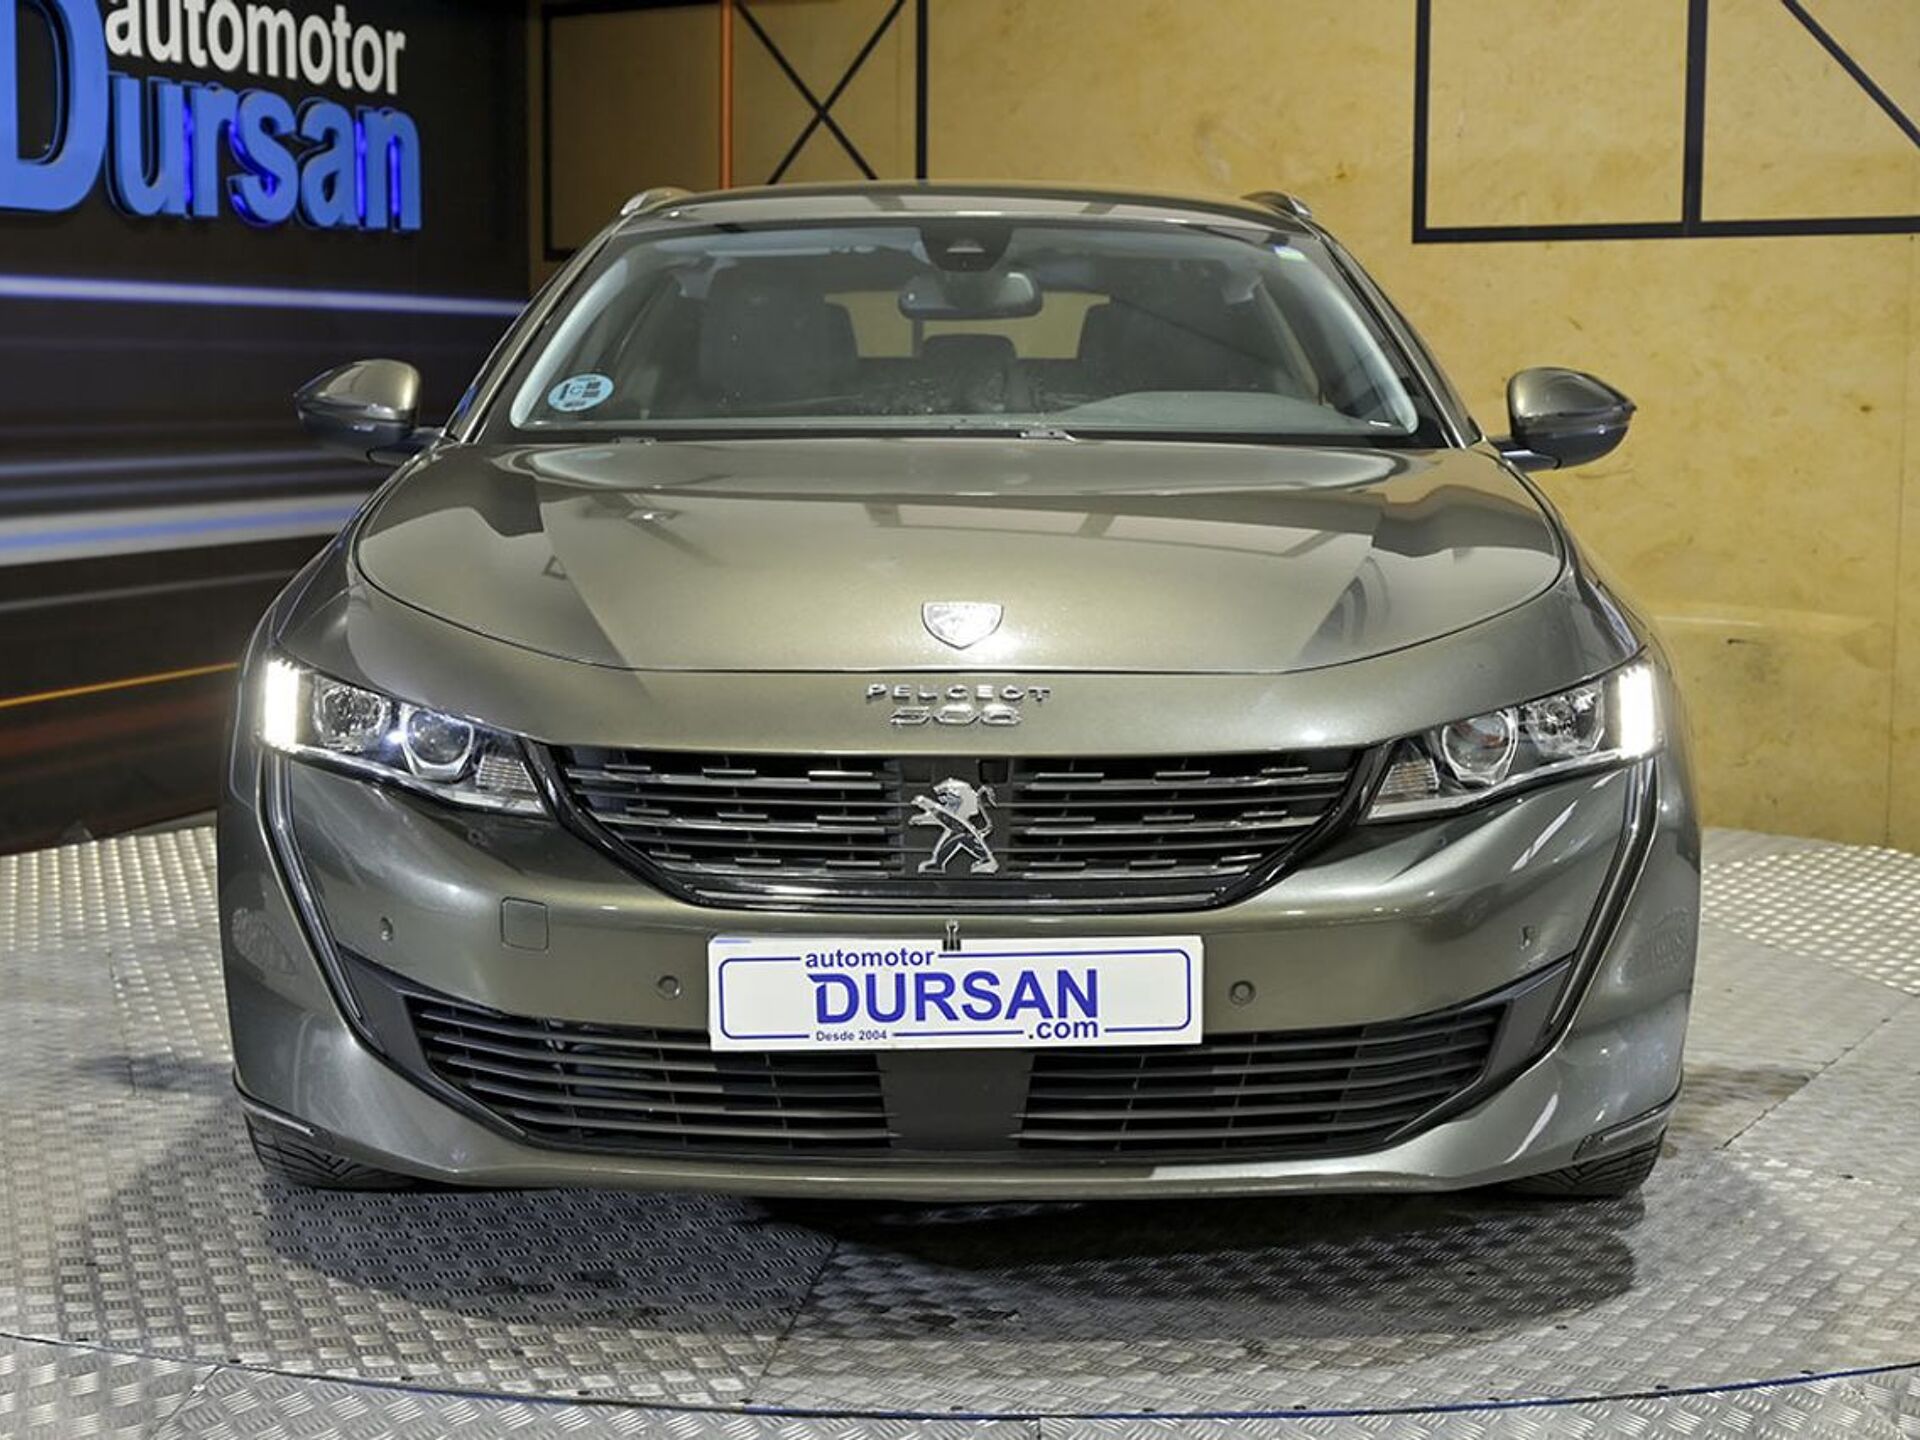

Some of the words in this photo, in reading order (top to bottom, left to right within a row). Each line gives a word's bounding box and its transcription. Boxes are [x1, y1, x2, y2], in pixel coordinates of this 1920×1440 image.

[104, 0, 406, 95] automotor
[0, 0, 422, 232] Dursan
[805, 948, 935, 968] automotor
[807, 968, 1098, 1024] DURSAN
[816, 1030, 856, 1042] Desde
[858, 1029, 888, 1041] 2004
[1028, 1020, 1098, 1040] .com
